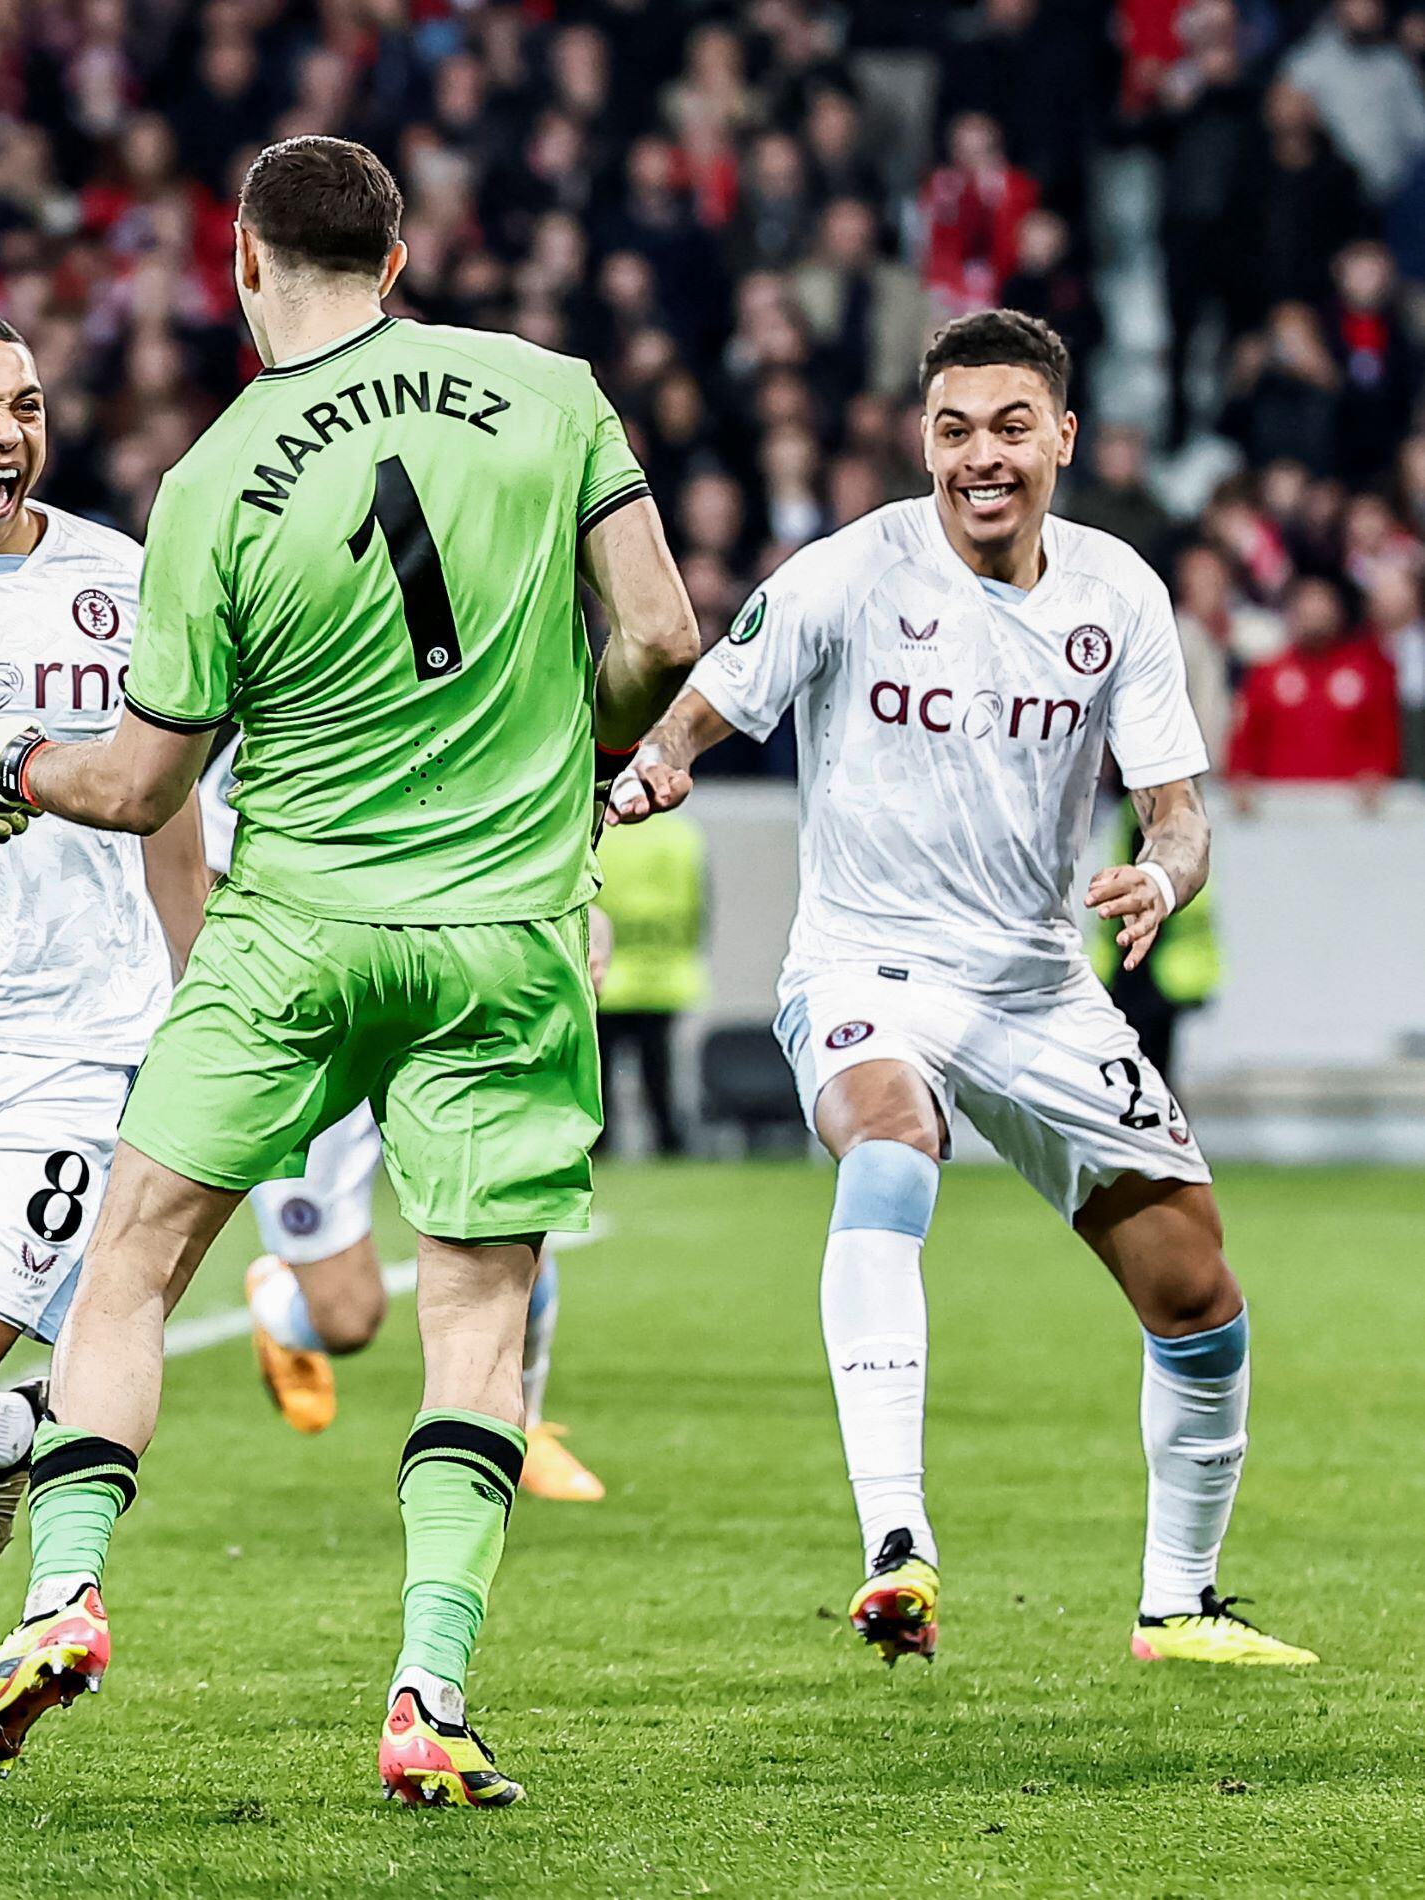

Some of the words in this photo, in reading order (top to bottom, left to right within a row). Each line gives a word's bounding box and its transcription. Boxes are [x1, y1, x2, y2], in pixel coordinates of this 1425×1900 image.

[240, 371, 511, 516] MARTINEZ
[346, 454, 463, 682] 1
[27, 1150, 89, 1242] 8
[841, 1360, 919, 1371] VILLA
